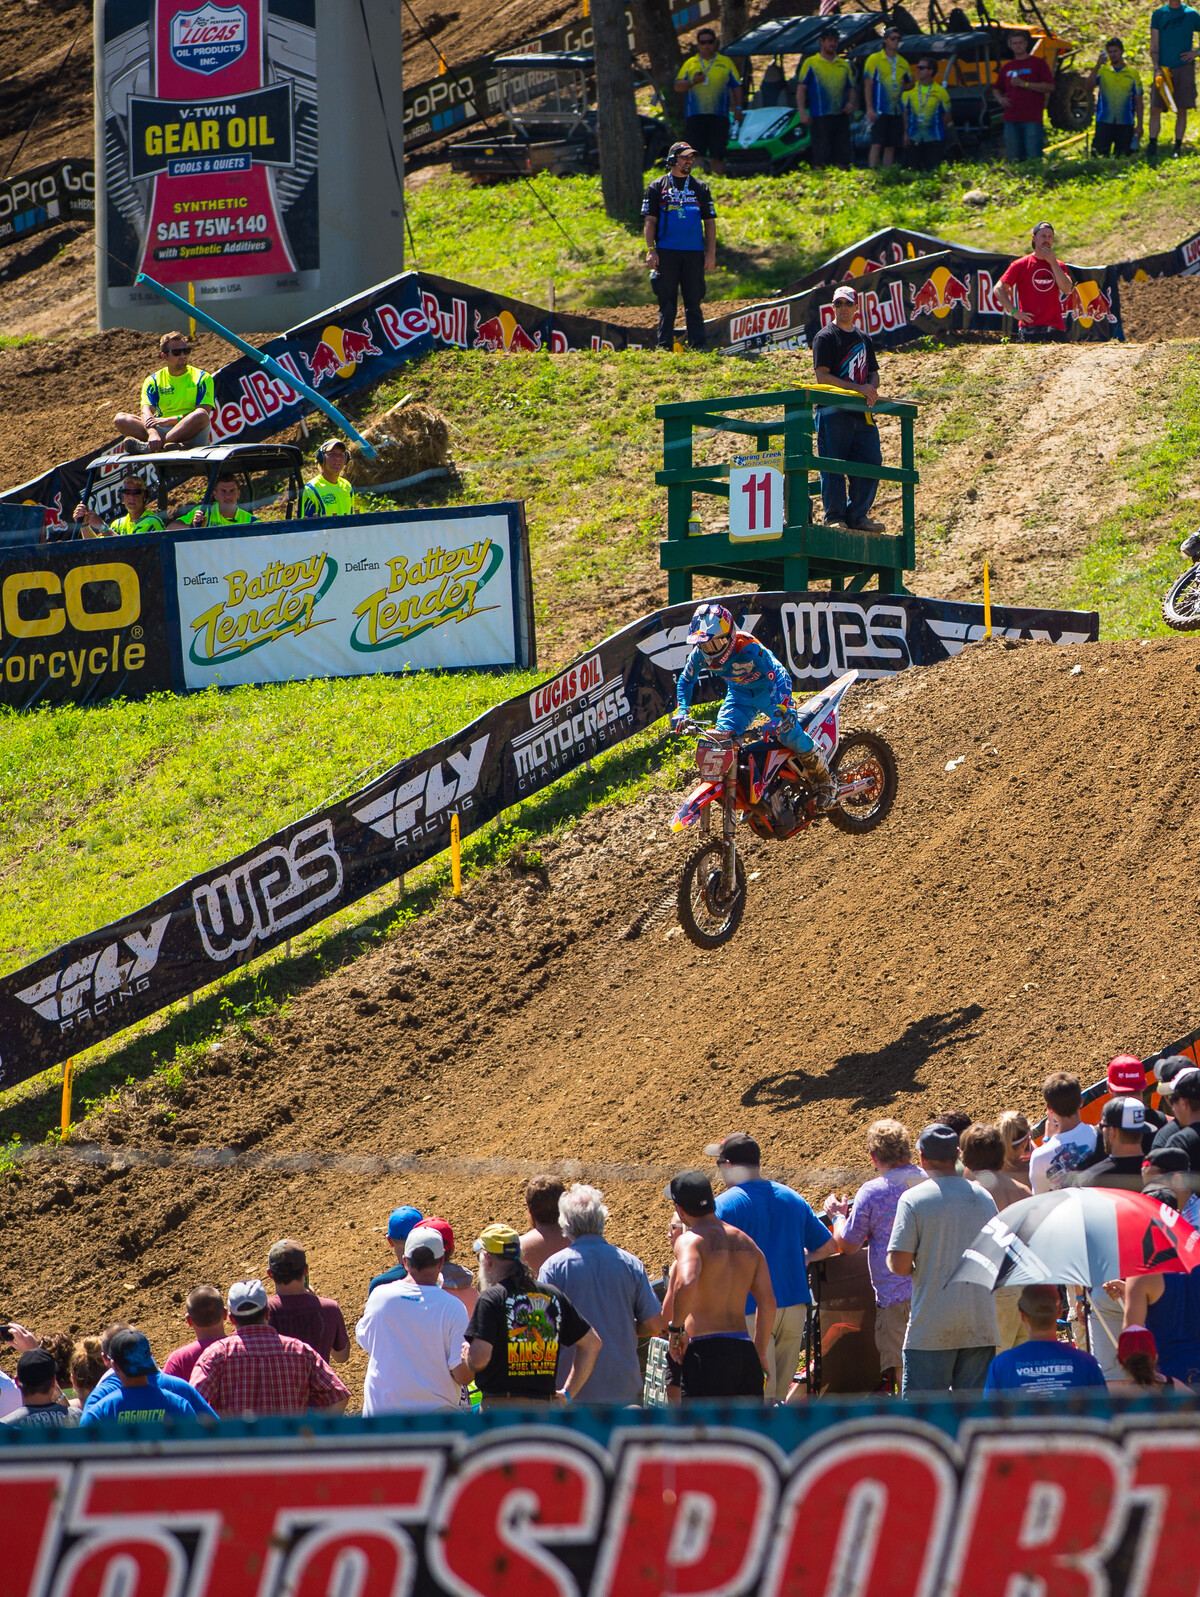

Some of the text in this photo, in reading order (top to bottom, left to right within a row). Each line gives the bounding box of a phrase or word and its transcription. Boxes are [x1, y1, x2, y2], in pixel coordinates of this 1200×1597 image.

[176, 44, 241, 57] OIL PRODUCTS
[180, 24, 240, 45] LUCAS
[200, 58, 218, 66] INC.
[179, 104, 236, 119] V-TWIN
[145, 116, 275, 156] GEAR OIL
[174, 158, 245, 174] COOLS & QUIETS
[157, 214, 268, 241] SAE 75W-140
[173, 197, 248, 214] SYNTHETIC
[159, 241, 266, 259] with Synthetic Additives
[201, 283, 242, 295] Made in USA
[732, 306, 791, 343] LUCAS OIL
[762, 450, 782, 460] Creek
[742, 472, 771, 530] 11
[223, 551, 328, 608] Battery
[385, 538, 494, 594] Battery
[0, 562, 141, 639] CO
[190, 589, 318, 659] Tender
[352, 578, 480, 645] Tender
[781, 602, 911, 678] WPS
[535, 658, 600, 719] LUCAS OIL
[554, 698, 588, 721] PRO
[513, 687, 631, 778] MOTOCROSS
[519, 714, 634, 790] CHAMPIONSHIP
[347, 734, 490, 839] FLY
[701, 750, 727, 777] 5
[395, 796, 474, 851] RACING
[192, 818, 344, 961] WPS
[14, 913, 172, 1021] FLY
[60, 976, 150, 1034] RACING
[1016, 1365, 1074, 1376] VOLUNTEER
